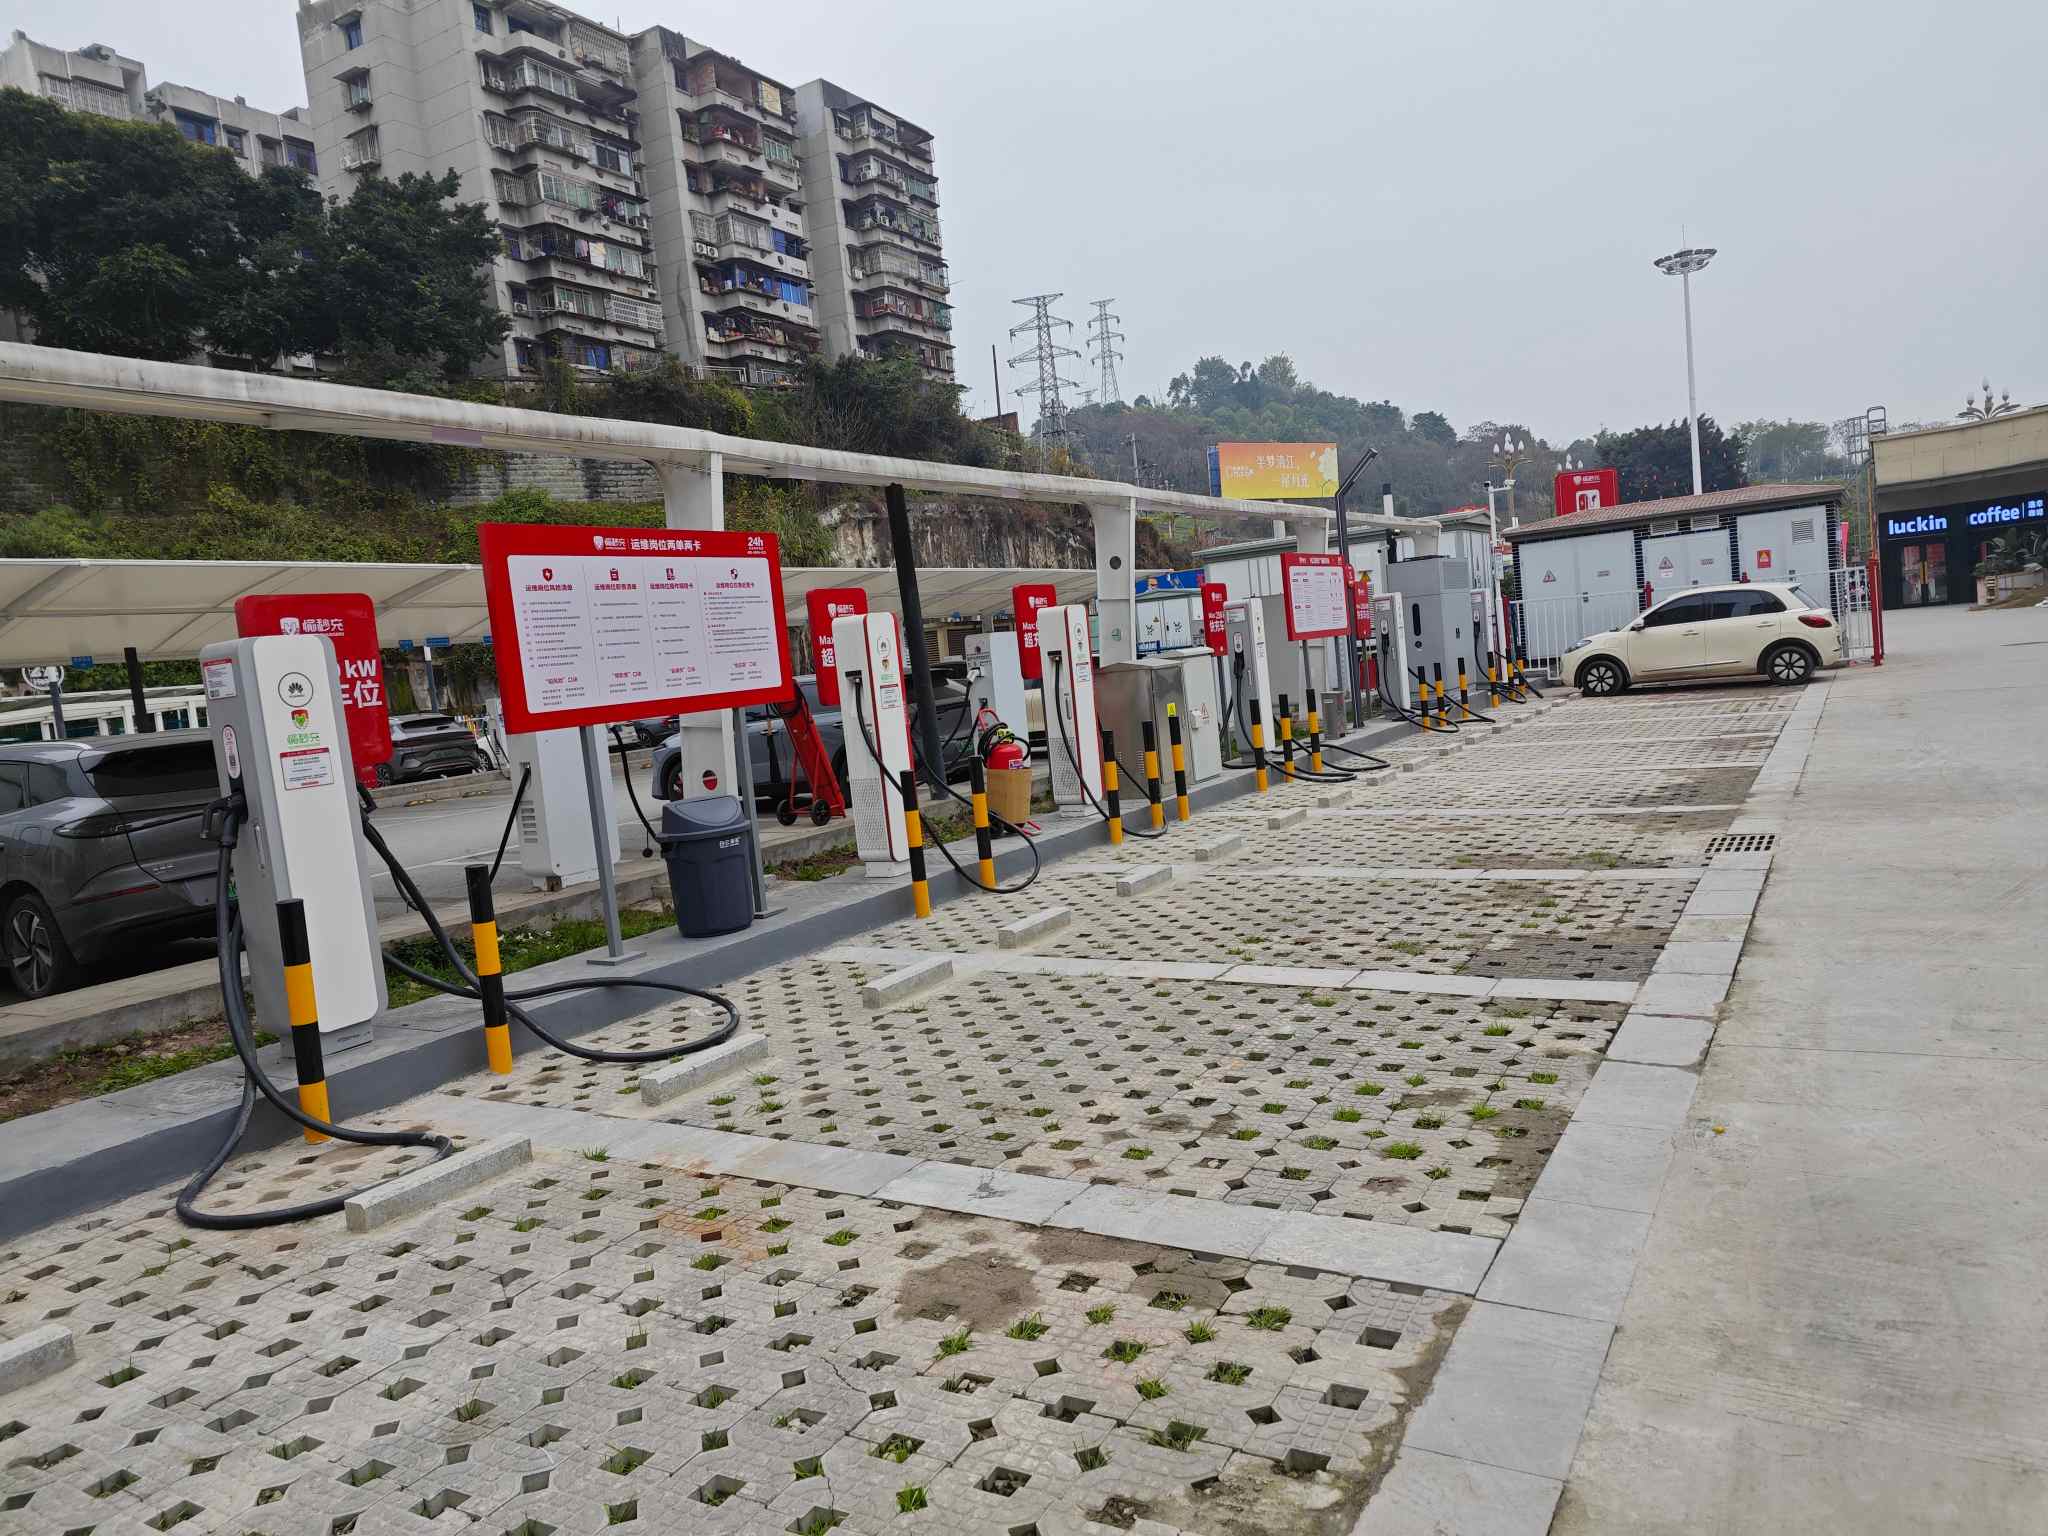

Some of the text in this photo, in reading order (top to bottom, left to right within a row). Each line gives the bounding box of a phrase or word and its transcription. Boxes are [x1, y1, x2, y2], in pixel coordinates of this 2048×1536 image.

[1888, 505, 2020, 535] luckin coffee
[630, 538, 701, 551] 运维岗位两单两卡
[747, 536, 763, 547] 24h
[344, 659, 376, 679] kW
